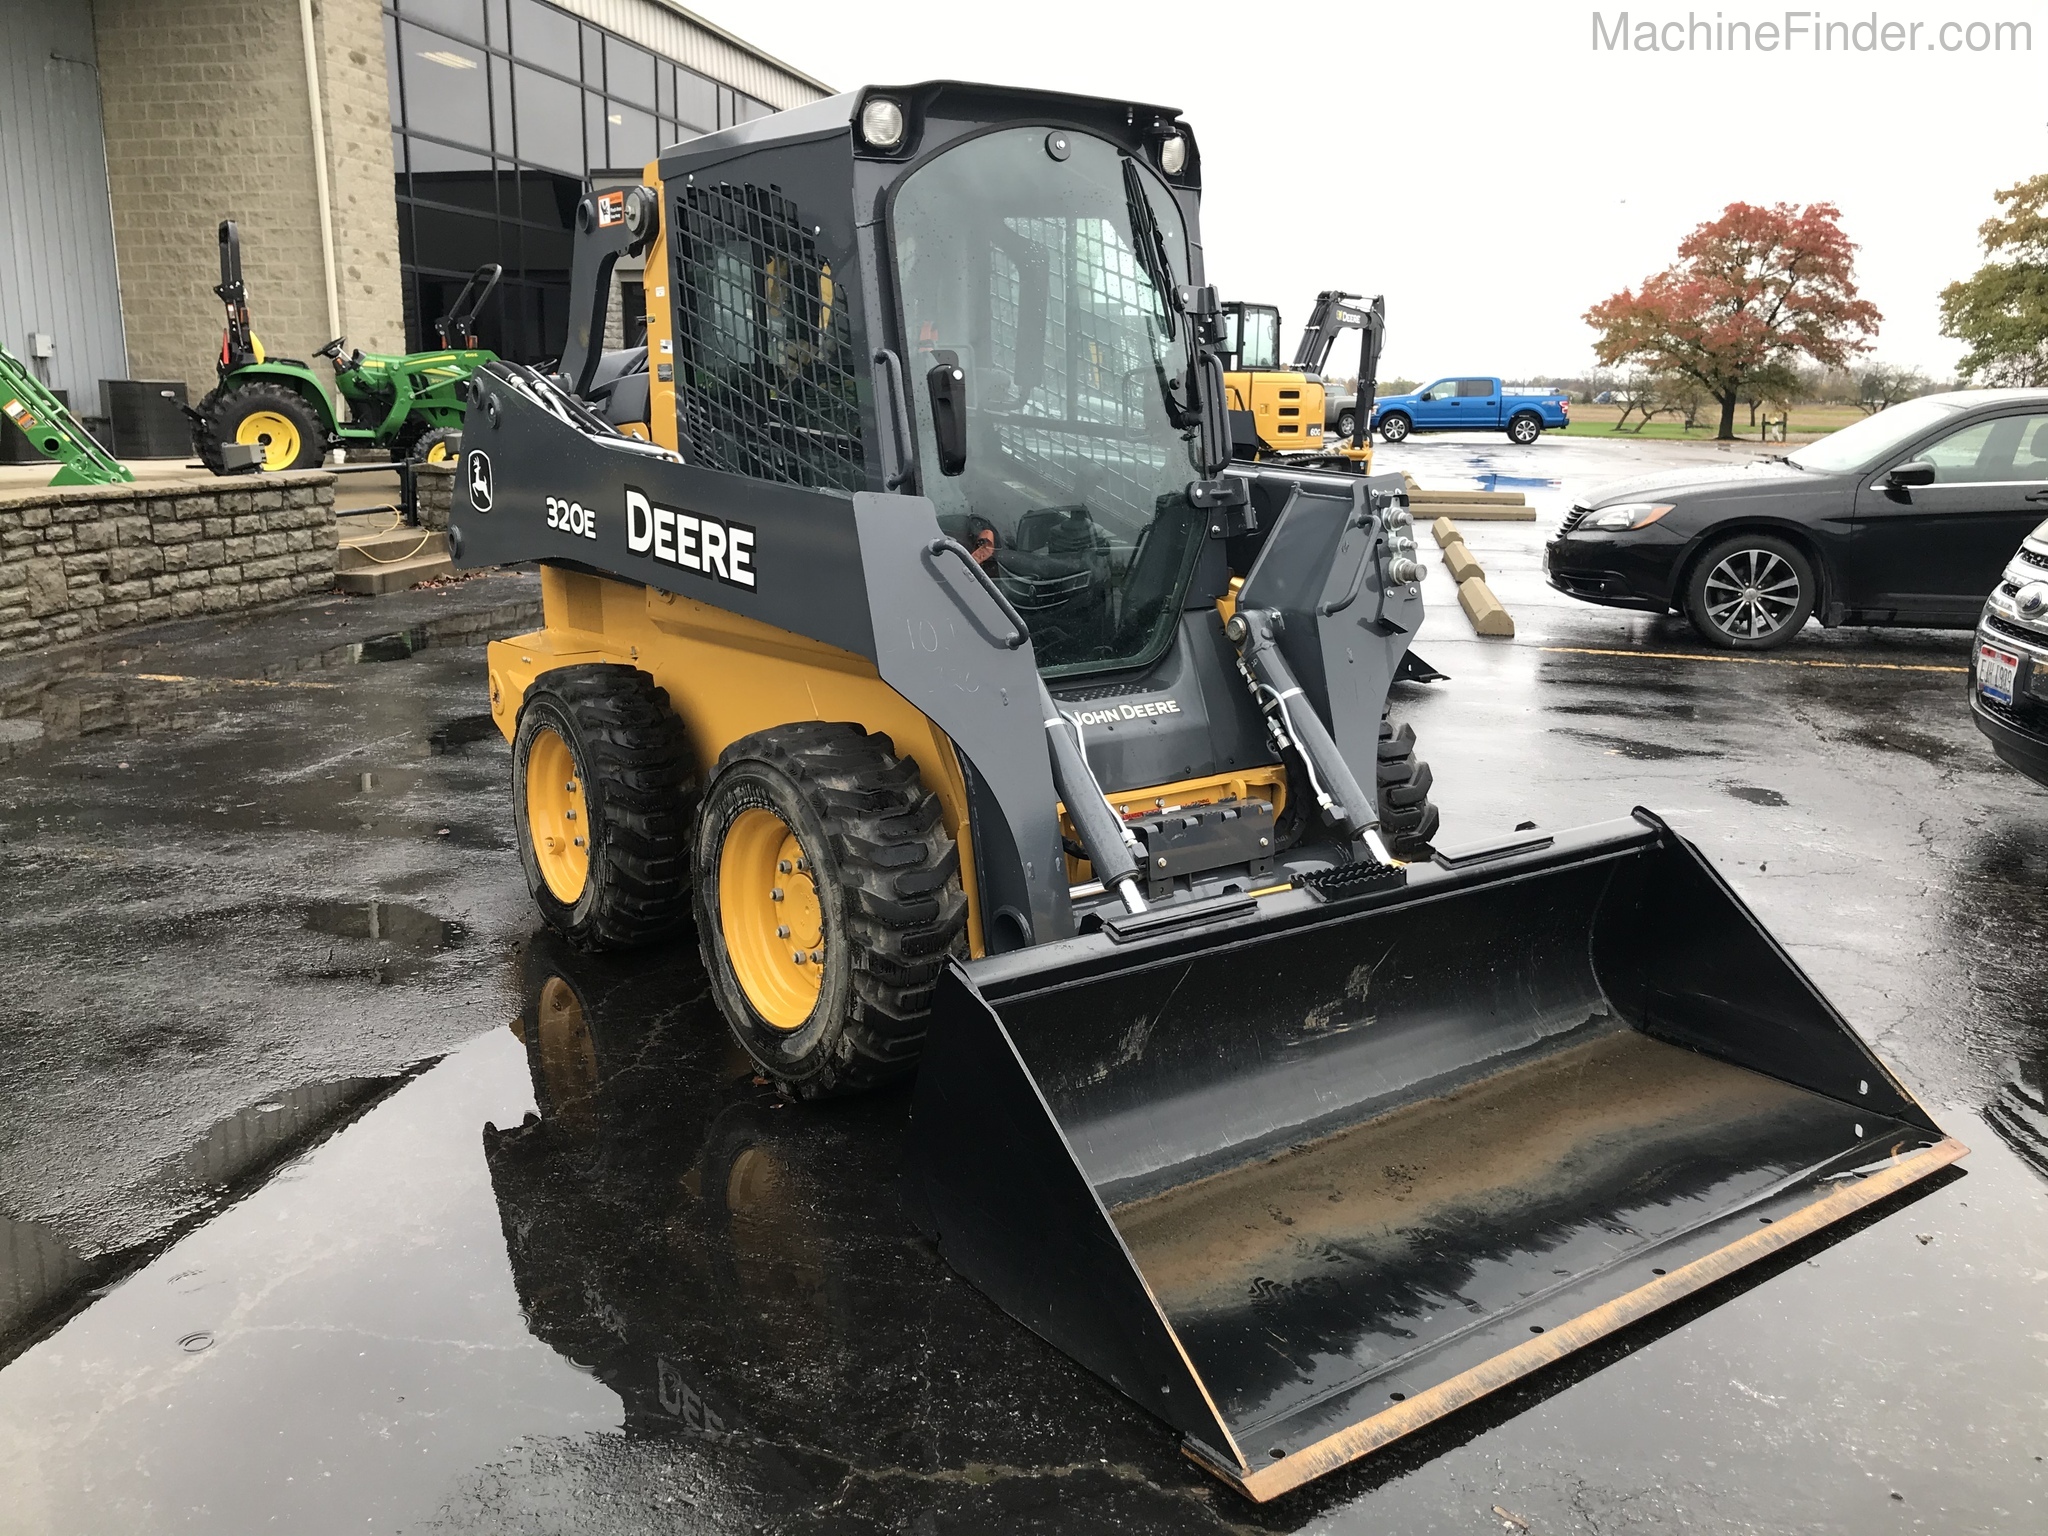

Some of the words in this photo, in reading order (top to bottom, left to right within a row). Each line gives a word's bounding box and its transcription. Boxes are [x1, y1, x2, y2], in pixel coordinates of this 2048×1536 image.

[1342, 311, 1361, 324] DEERE
[546, 496, 597, 540] 320E
[625, 489, 756, 588] DEERE
[1073, 708, 1120, 726] JOHN
[1119, 700, 1181, 720] DEERE
